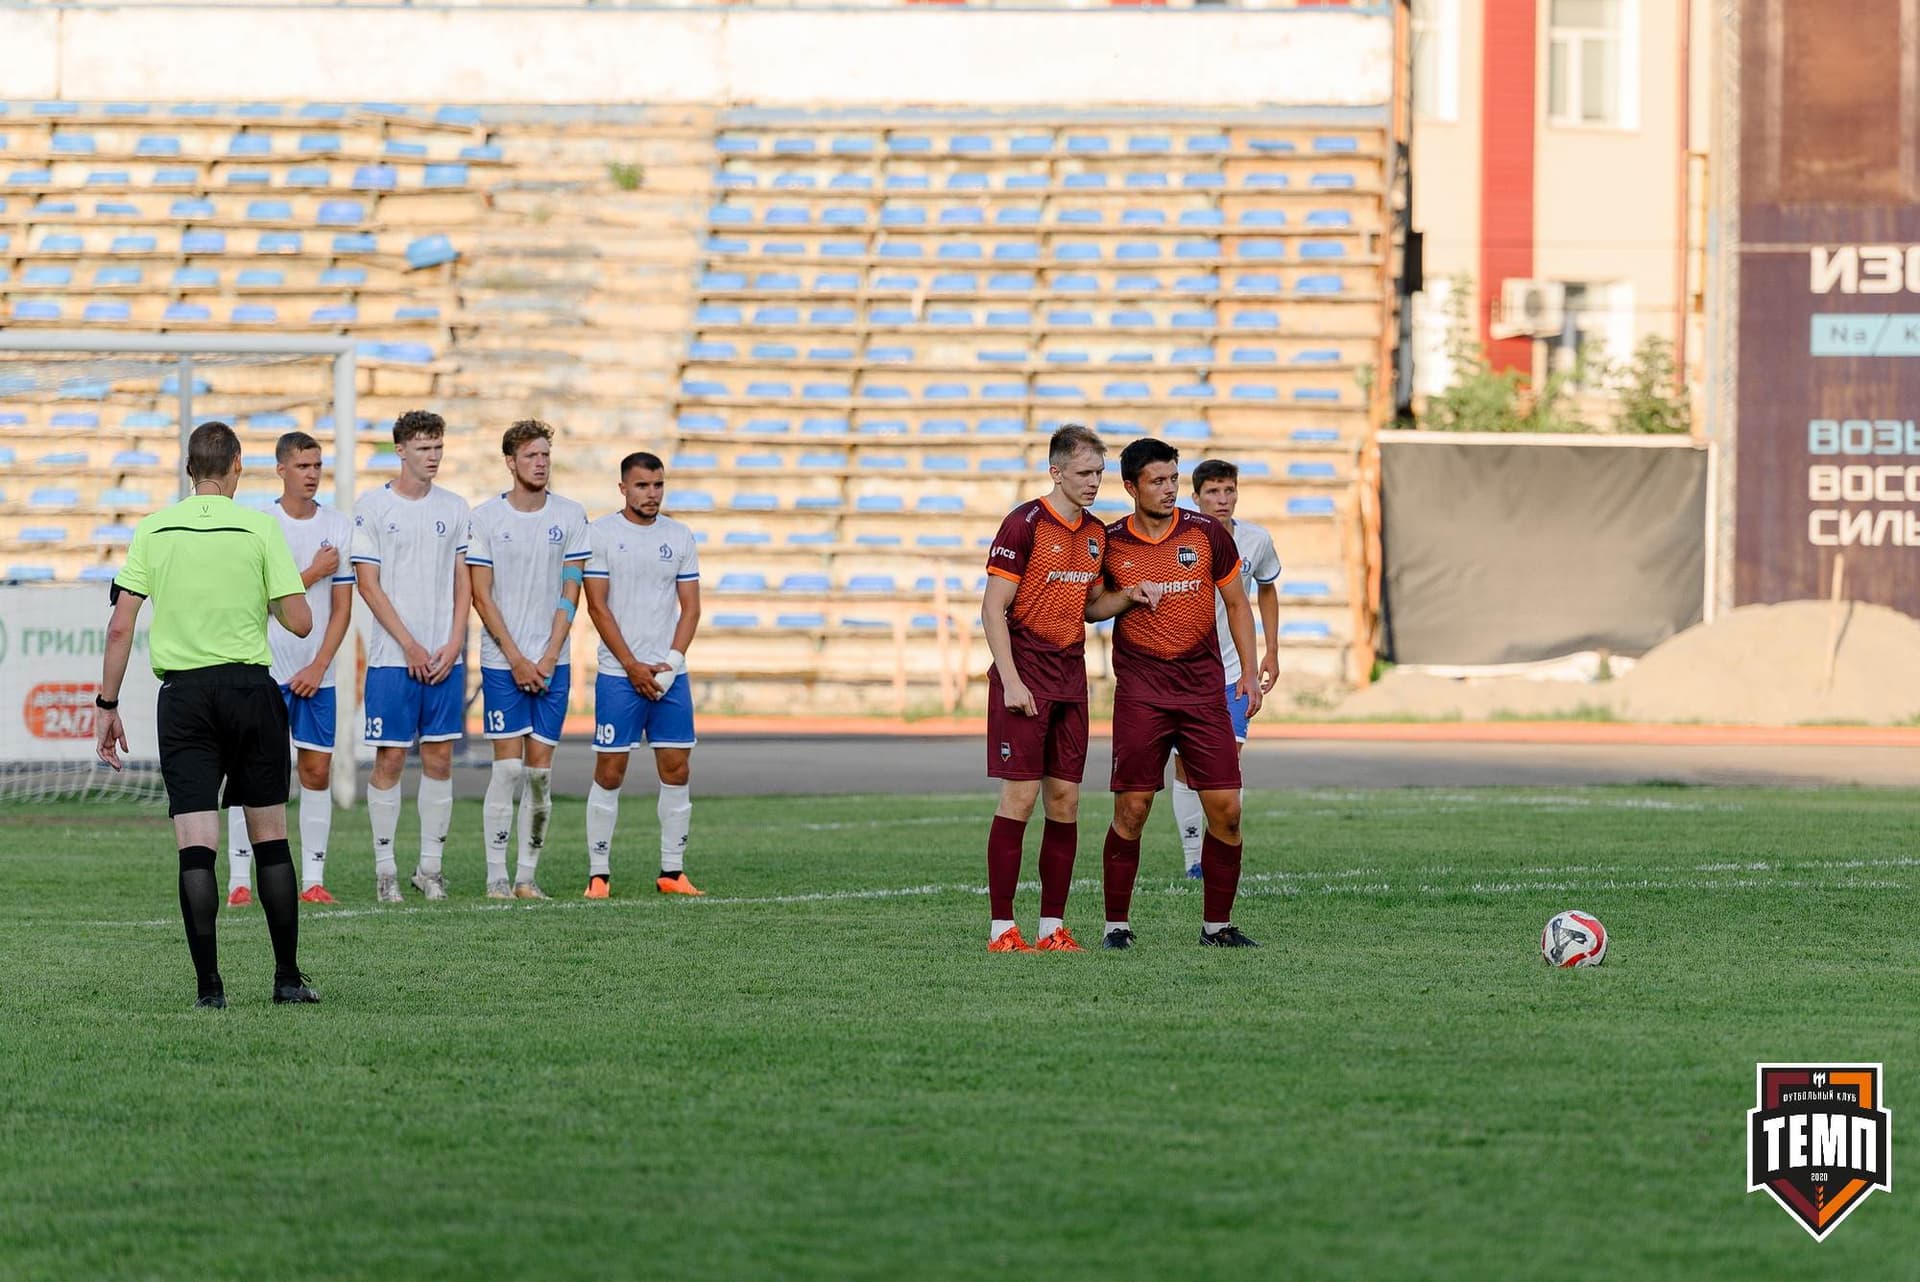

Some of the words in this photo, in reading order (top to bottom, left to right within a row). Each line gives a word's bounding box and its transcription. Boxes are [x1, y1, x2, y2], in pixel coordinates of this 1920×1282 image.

[996, 546, 1016, 560] ПСБ
[487, 710, 505, 731] 13
[596, 723, 615, 744] 49
